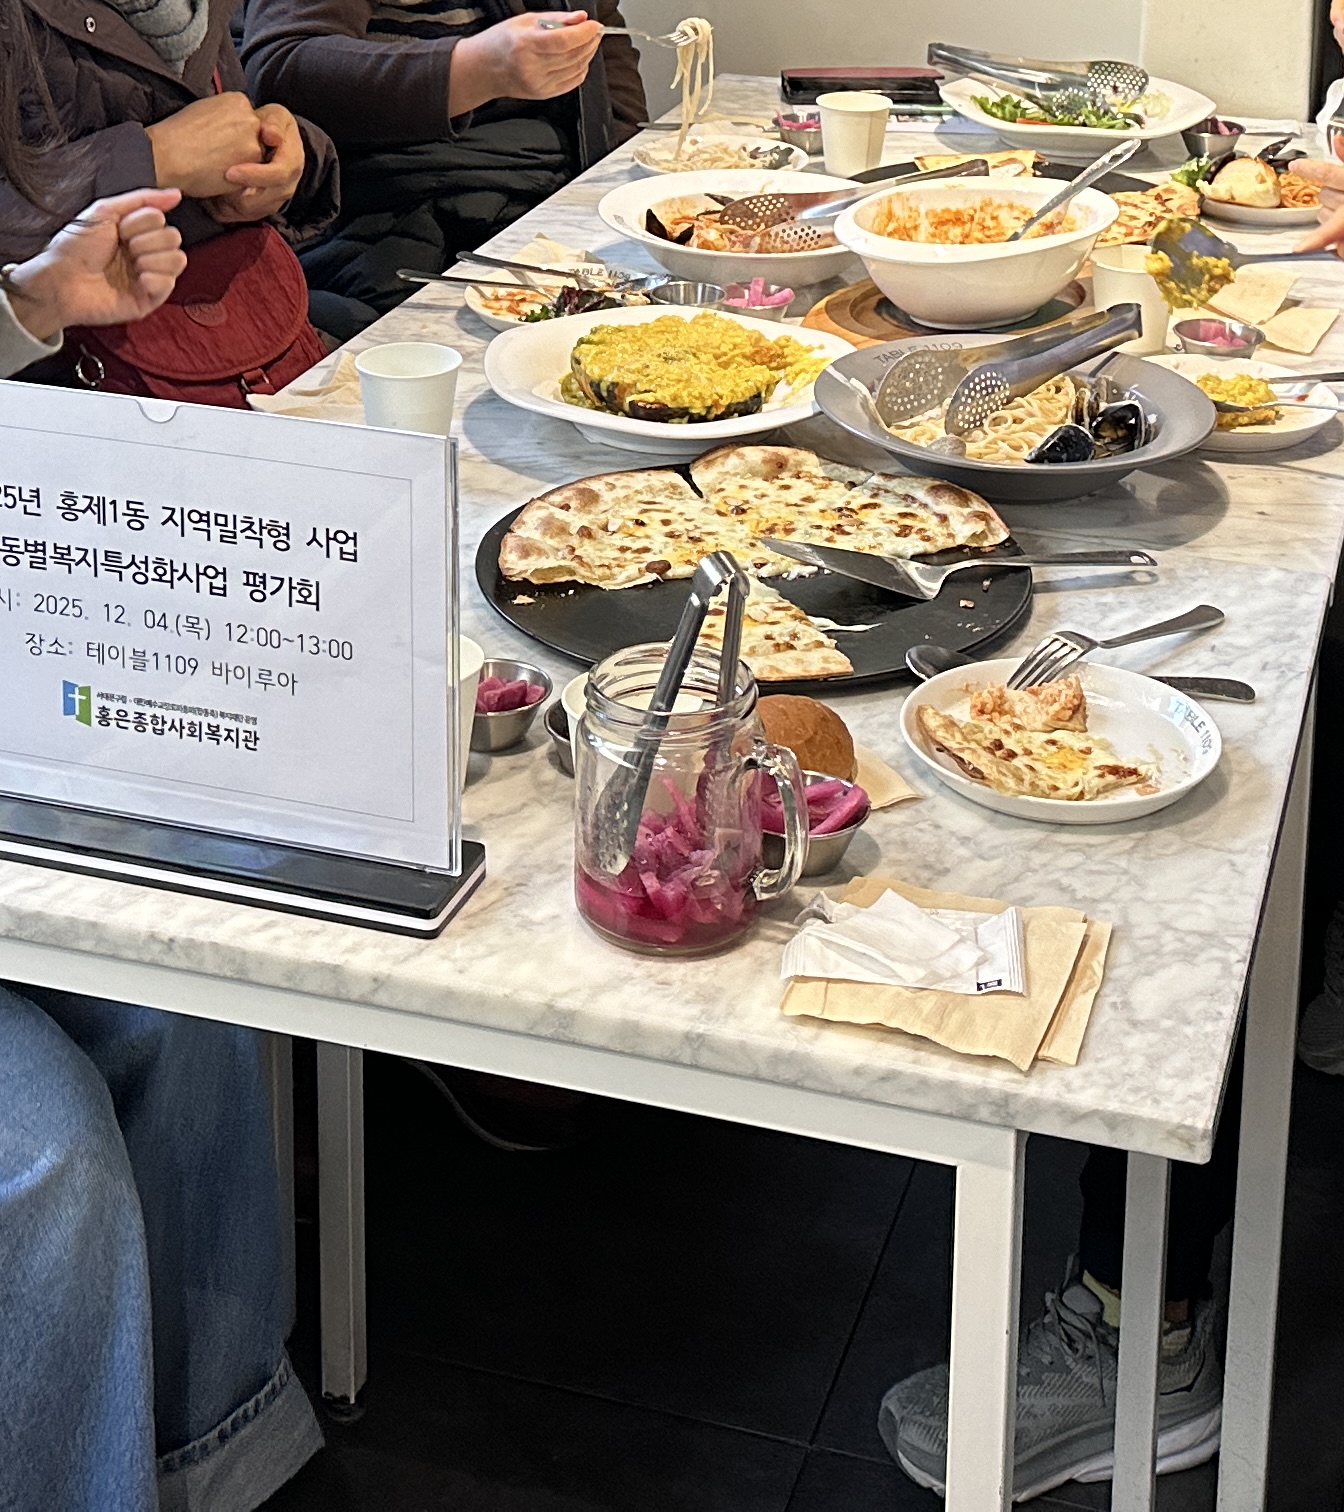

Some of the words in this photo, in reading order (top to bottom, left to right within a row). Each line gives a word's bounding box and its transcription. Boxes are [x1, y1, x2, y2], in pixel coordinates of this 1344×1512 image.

[55, 490, 150, 532] 홍제1동
[160, 505, 291, 553] 지역밀착형
[305, 526, 358, 564] 사업
[242, 569, 321, 612] 평가회
[33, 592, 90, 621] 2025.
[103, 602, 132, 627] 12.
[143, 608, 212, 642] 04.(목)
[224, 622, 354, 662] 12:00~13:00
[24, 631, 74, 658] 장소:
[86, 641, 199, 678] 테이블1109
[211, 660, 299, 698] 바이루아
[94, 704, 261, 752] 홍은종합사회복지관
[1174, 700, 1207, 734] TABLE
